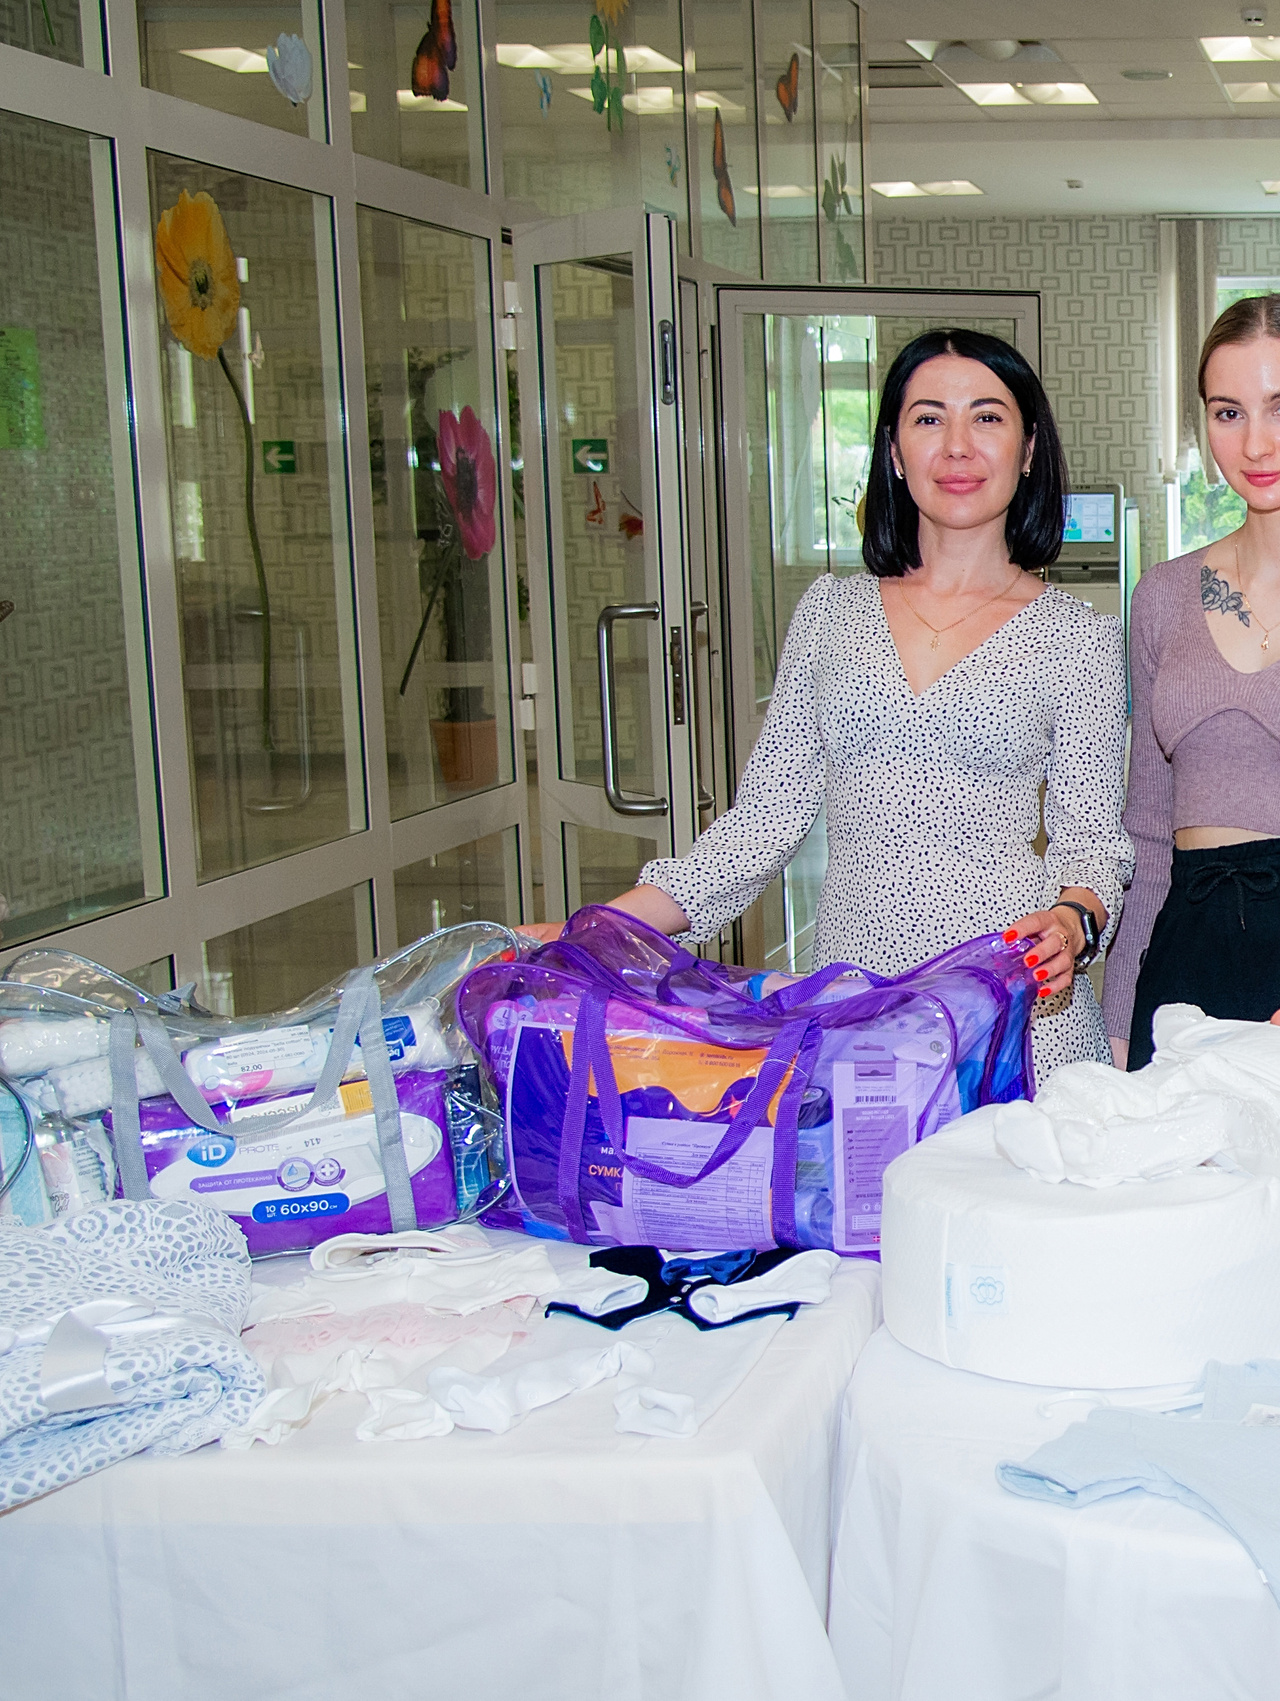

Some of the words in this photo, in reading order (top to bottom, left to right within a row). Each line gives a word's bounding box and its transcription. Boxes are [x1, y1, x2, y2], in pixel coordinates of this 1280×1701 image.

[241, 1064, 262, 1072] 82,00
[201, 1144, 227, 1161] iD
[239, 1144, 280, 1154] PROTE
[233, 1176, 273, 1184] ПРОТЕКАНИЙ
